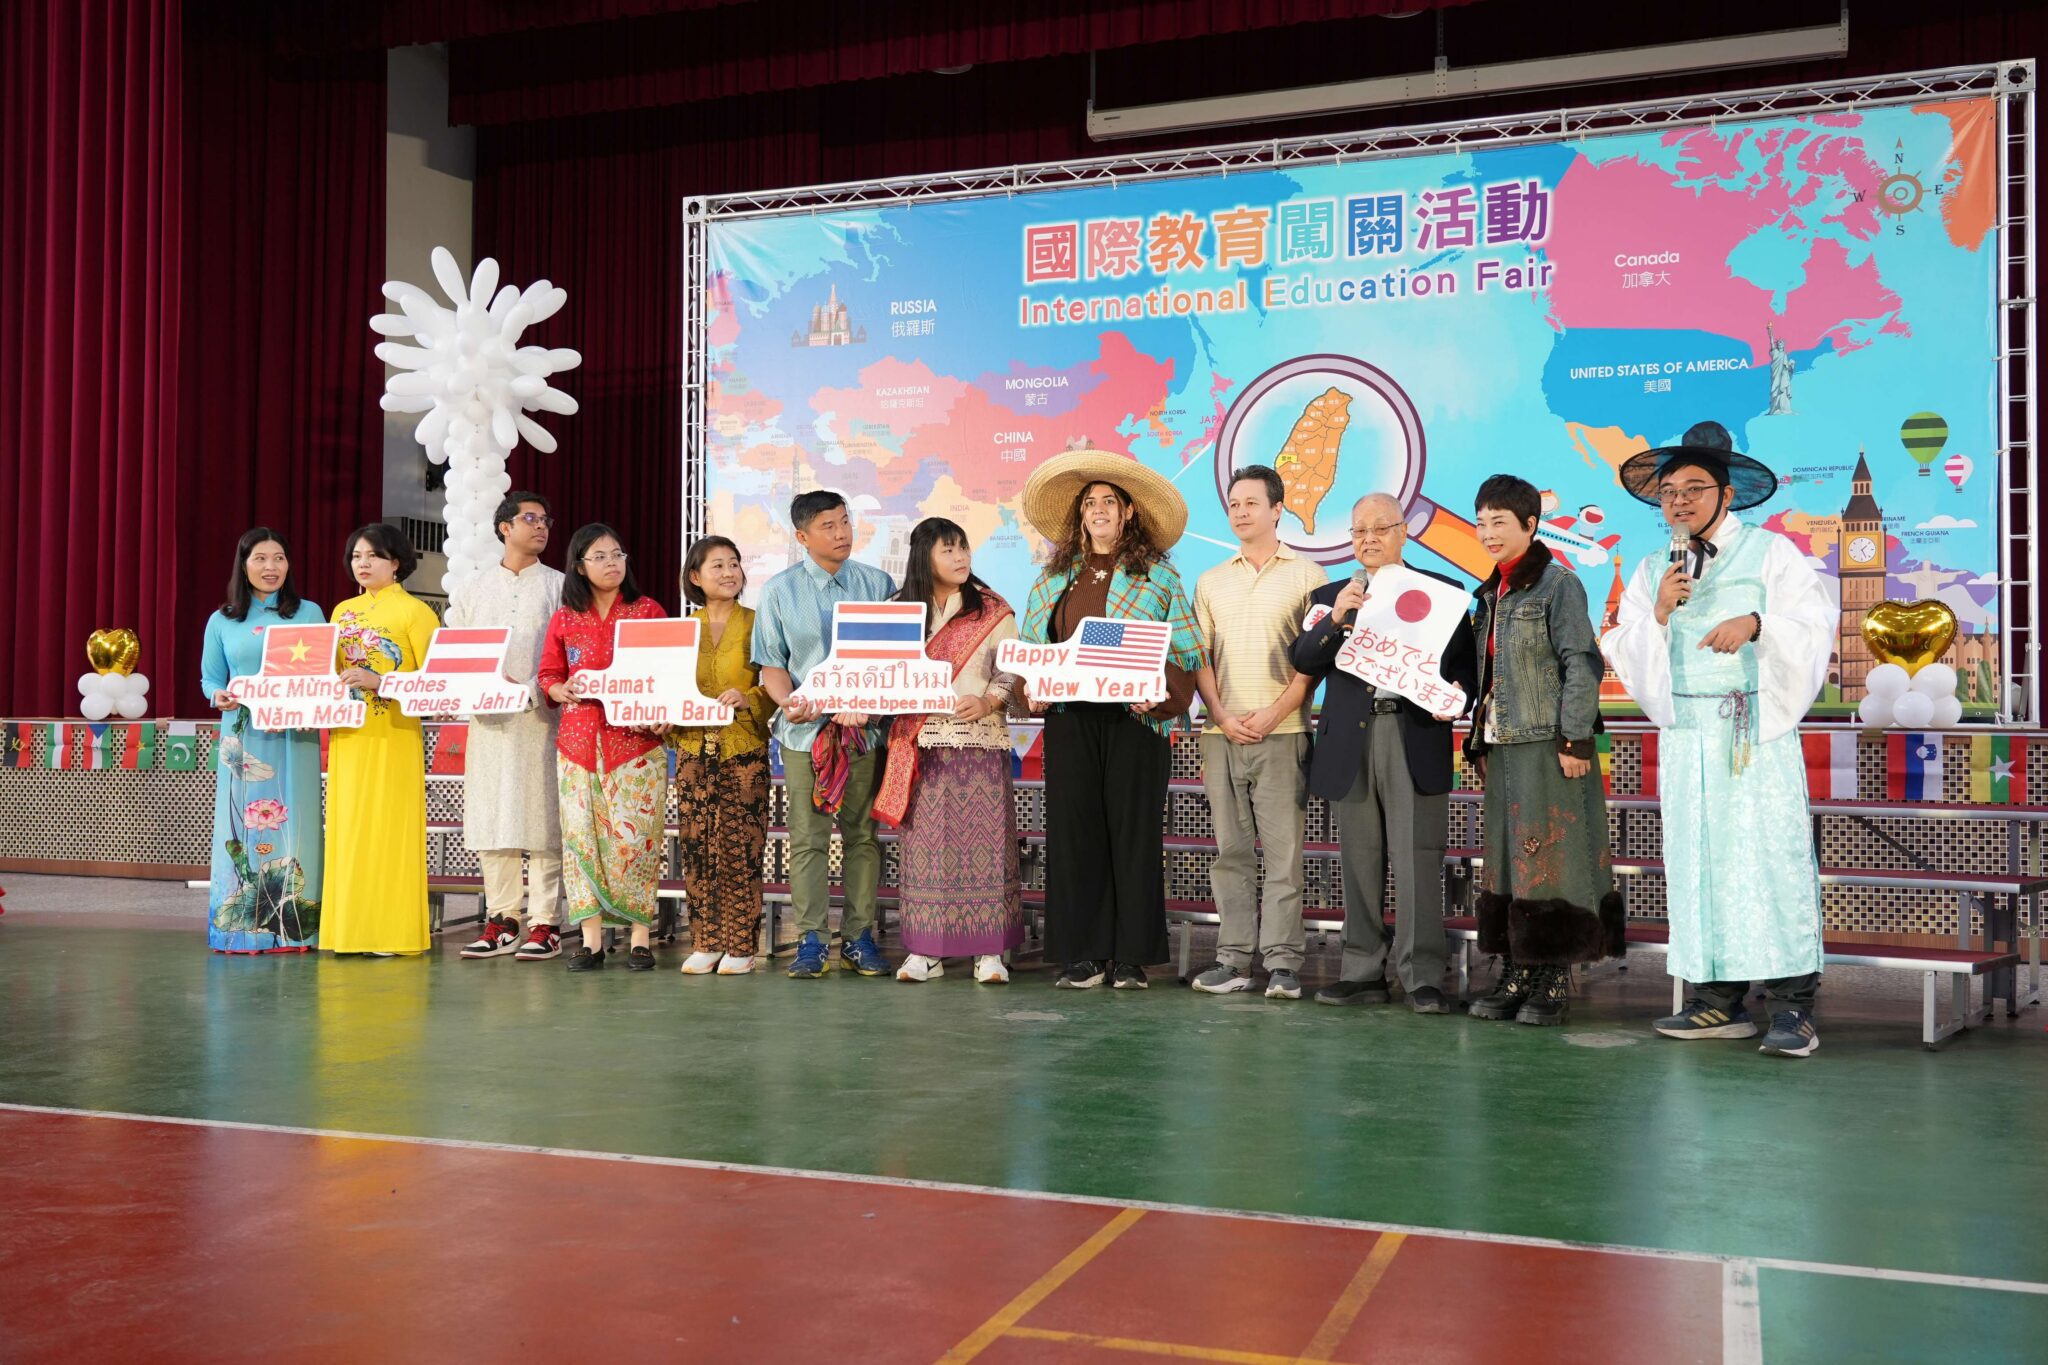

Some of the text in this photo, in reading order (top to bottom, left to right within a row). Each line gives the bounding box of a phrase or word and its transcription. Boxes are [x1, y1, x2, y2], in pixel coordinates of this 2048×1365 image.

[1894, 153, 1904, 164] N
[1853, 189, 1866, 202] W
[1935, 184, 1944, 195] E
[1026, 179, 1549, 283] 國際教育闖關活動
[1896, 225, 1905, 236] S
[1614, 250, 1681, 268] Canada
[1622, 271, 1672, 289] 加拿大
[1021, 257, 1554, 325] International Education Fair
[890, 299, 937, 316] RUSSIA
[891, 318, 936, 338] 俄羅斯
[1569, 358, 1750, 380] UNITED STATES OF AMERICA
[1005, 376, 1069, 390] MONGOLIA
[1643, 378, 1672, 394] 美國
[1024, 392, 1048, 407] 蒙古
[993, 431, 1034, 444] CHINA
[1000, 448, 1026, 463] 中國
[1001, 643, 1070, 666] Happy
[1353, 627, 1438, 675] おめでと
[576, 673, 655, 694] Selamat
[812, 660, 949, 689] สวัสดีปีใหม่
[1339, 646, 1463, 711] うございます
[229, 677, 346, 700] Chúc Mừng
[381, 675, 448, 693] Frohes
[1037, 676, 1161, 697] New Year!
[406, 697, 461, 712] neues
[610, 699, 729, 721] Tahun Baru
[879, 695, 918, 712] bpee
[256, 706, 303, 727] Năm
